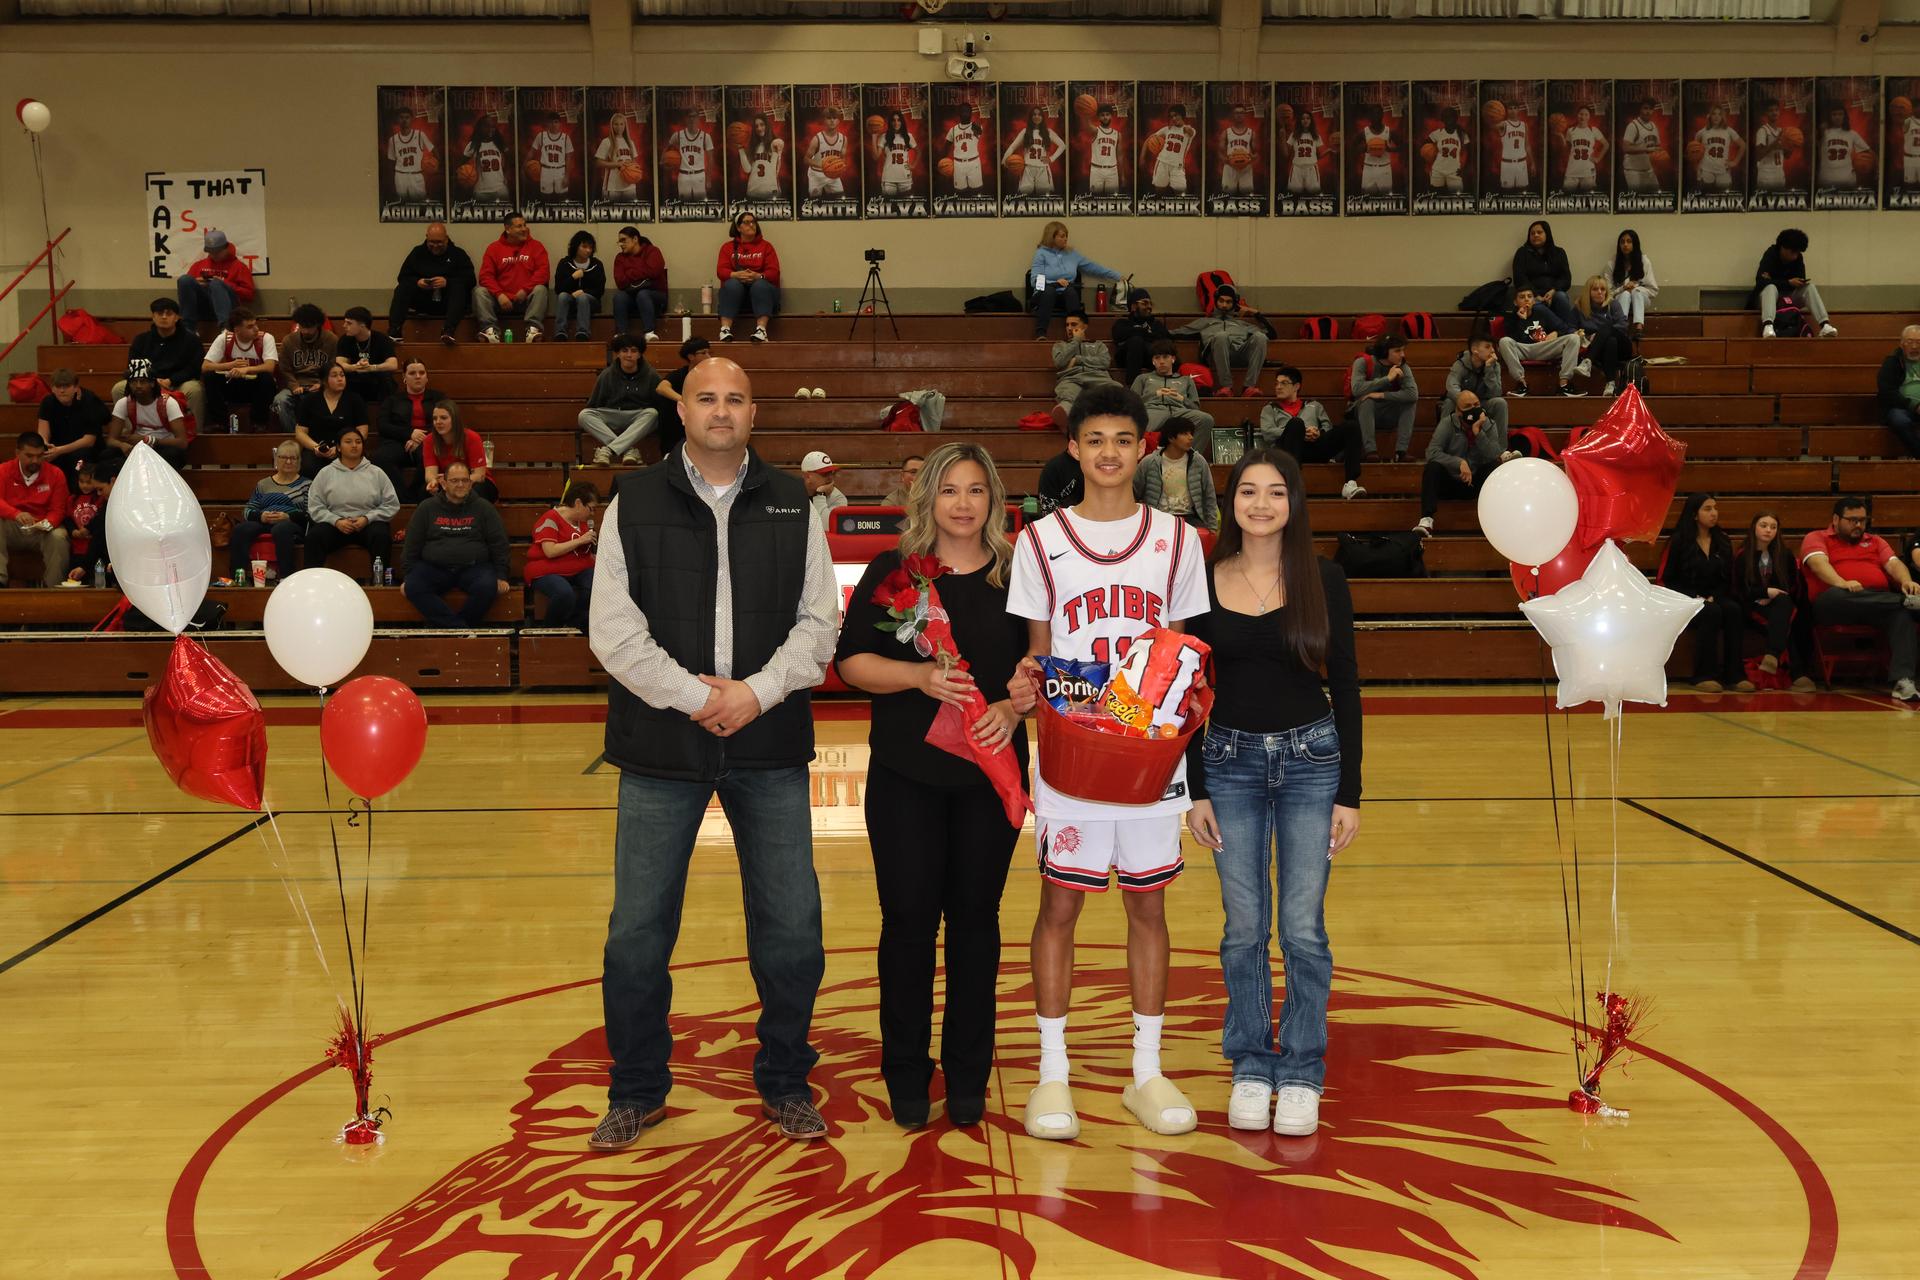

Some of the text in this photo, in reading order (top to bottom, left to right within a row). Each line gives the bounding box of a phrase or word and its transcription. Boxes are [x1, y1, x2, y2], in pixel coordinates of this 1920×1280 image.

[961, 142, 968, 152] 4
[1442, 148, 1457, 158] 24
[1709, 147, 1724, 158] 42
[757, 164, 765, 177] 3
[187, 178, 252, 200] THAT
[933, 201, 997, 216] VAUGHN
[1003, 200, 1065, 216] MARION
[1070, 199, 1133, 215] ESCHEIK
[1138, 199, 1200, 215] ESCHEIK
[1213, 200, 1261, 214] BASS
[1282, 200, 1333, 214] BASS
[1346, 200, 1407, 213] HEMPHILL
[1414, 199, 1475, 213] MOORE
[1479, 198, 1543, 210] DEATHERAGE
[1548, 198, 1610, 211] GONSALVES
[1619, 197, 1673, 208] ROMINE
[1682, 197, 1744, 209] MARCEAUX
[1815, 195, 1876, 209] MENDOZA
[381, 207, 444, 220] AGUILAR
[521, 207, 584, 220] WALTERS
[591, 206, 651, 219] NEWTON
[660, 205, 724, 218] BEARDSLEY
[801, 203, 858, 217] SMITH
[867, 202, 928, 217] SILVA
[150, 180, 173, 277] TAKE
[293, 349, 328, 368] GAP
[857, 521, 881, 530] BONUS
[1063, 584, 1164, 636] TRIBE
